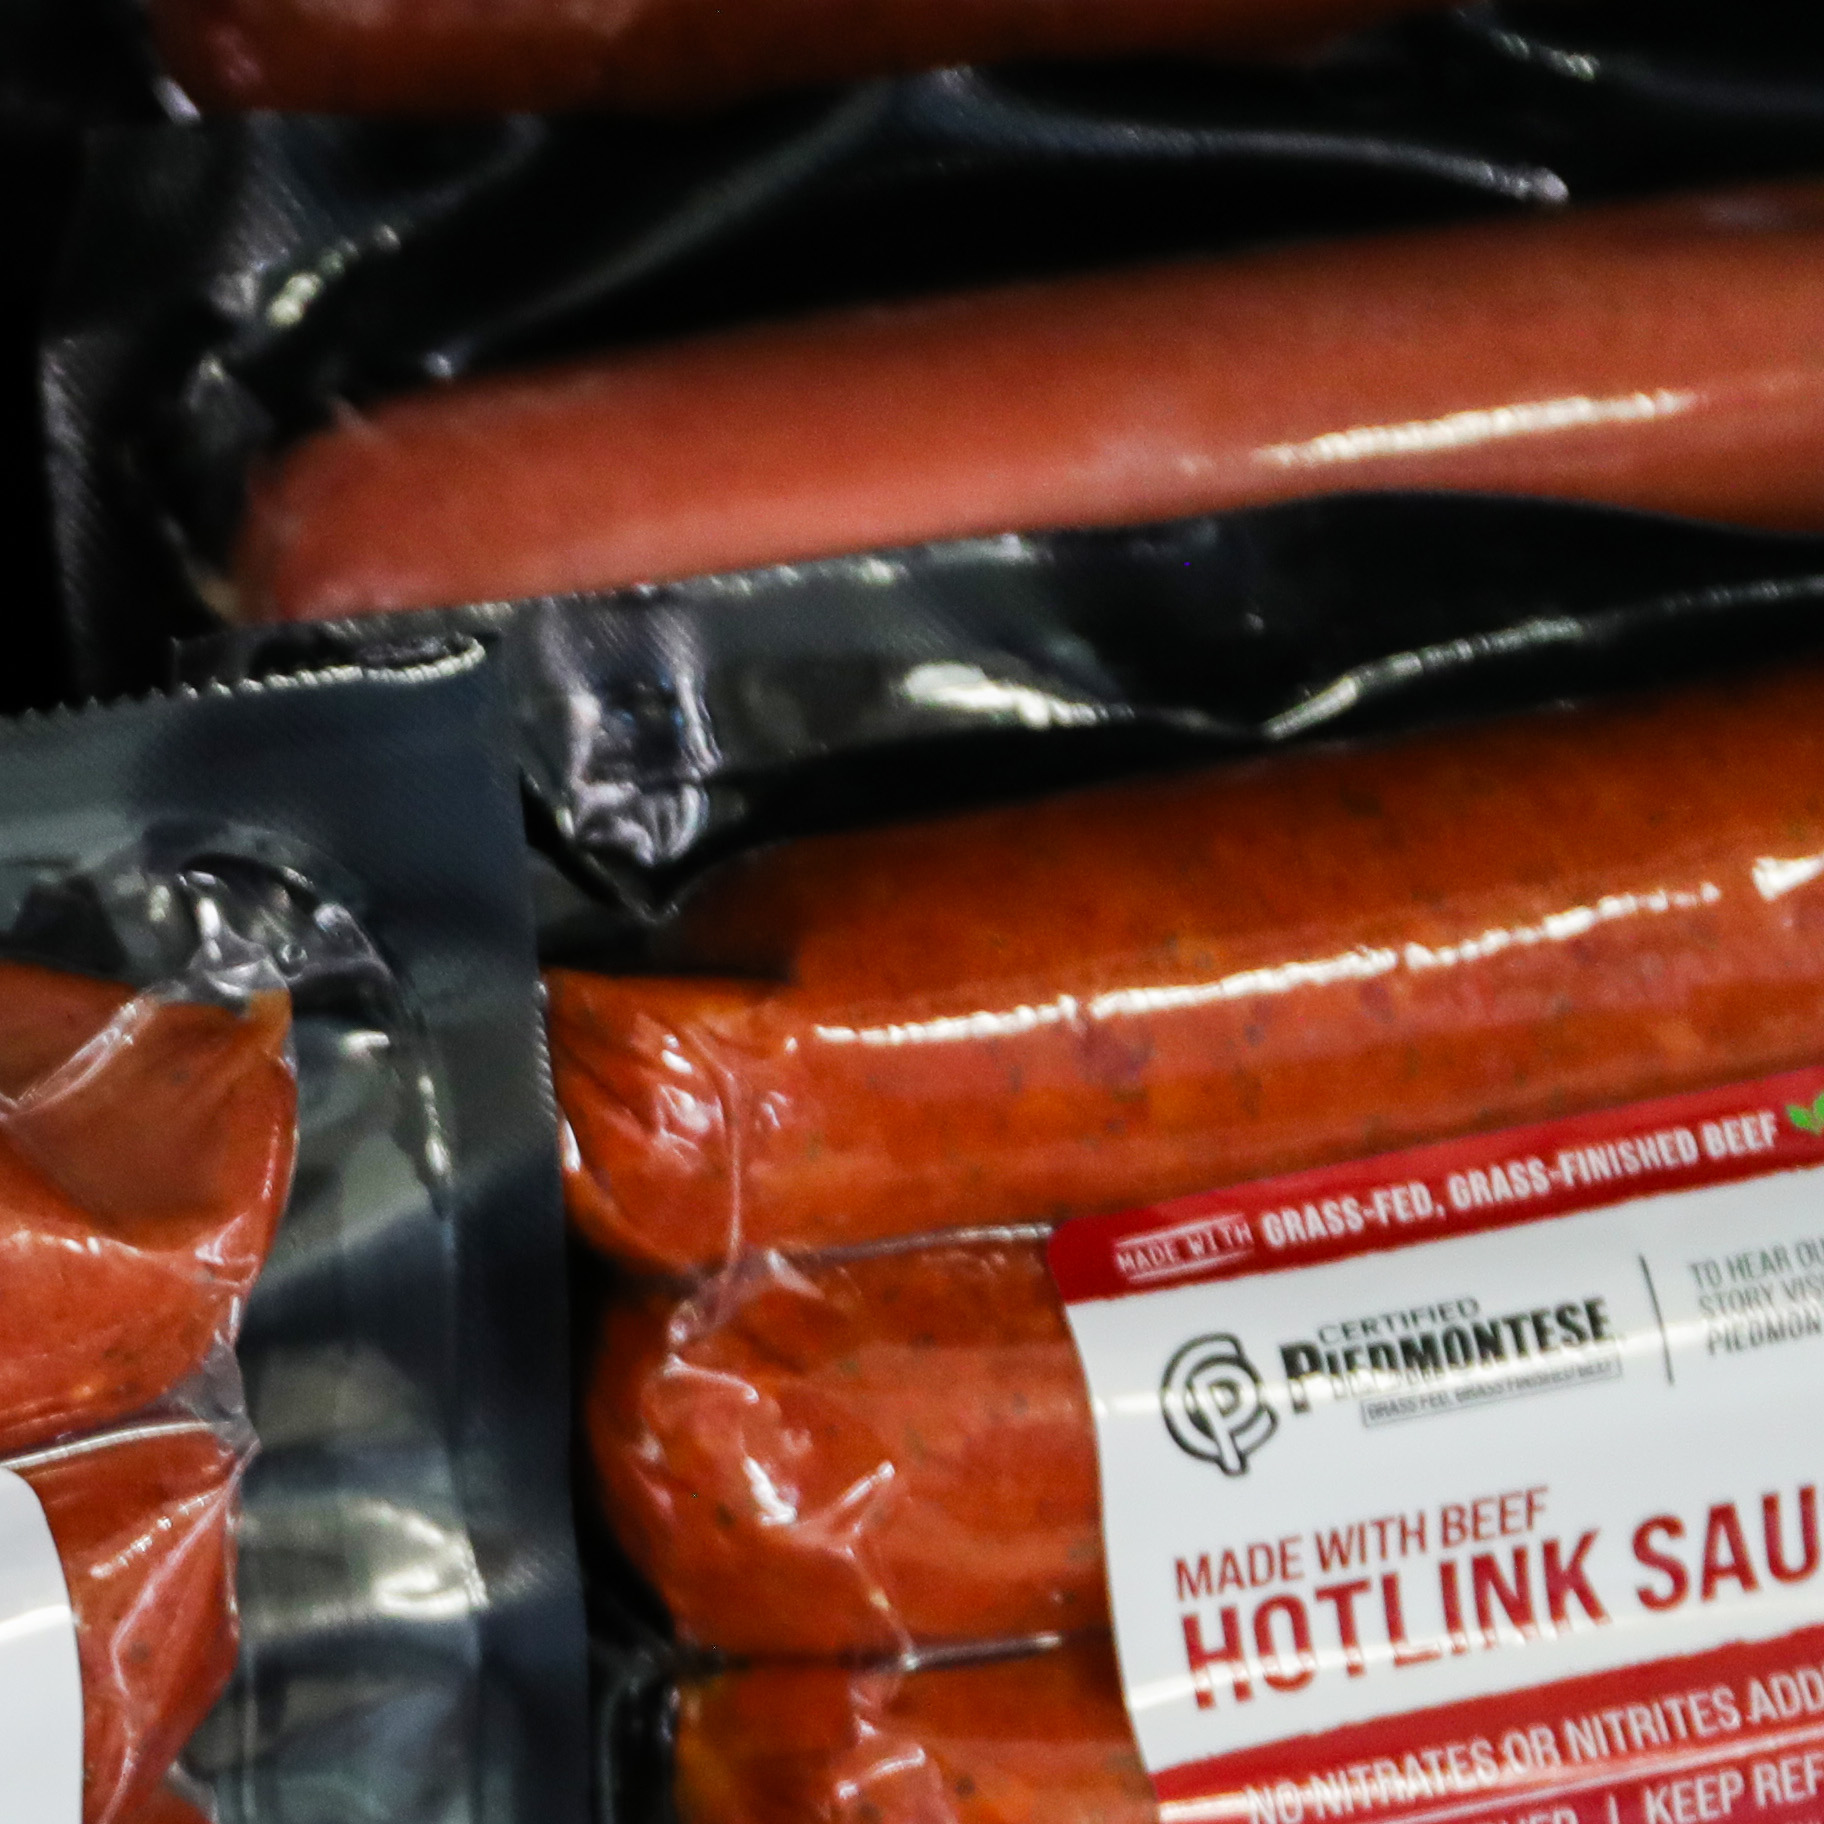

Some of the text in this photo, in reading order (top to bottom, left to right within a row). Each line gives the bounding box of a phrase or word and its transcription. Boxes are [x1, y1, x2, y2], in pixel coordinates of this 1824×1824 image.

[1260, 1180, 1448, 1251] GRASS-FED,
[1447, 1125, 1700, 1213] GRASS-FINISHED
[1701, 1110, 1778, 1160] BEEF
[1317, 1297, 1481, 1345] CERTIFIED
[1174, 1484, 1550, 1602] MADE WITH BEEF
[1181, 1527, 1613, 1711] HOTLINK
[1309, 1738, 1502, 1823] NITRATES
[1502, 1723, 1564, 1776] OR
[1563, 1684, 1743, 1765] NITRITES
